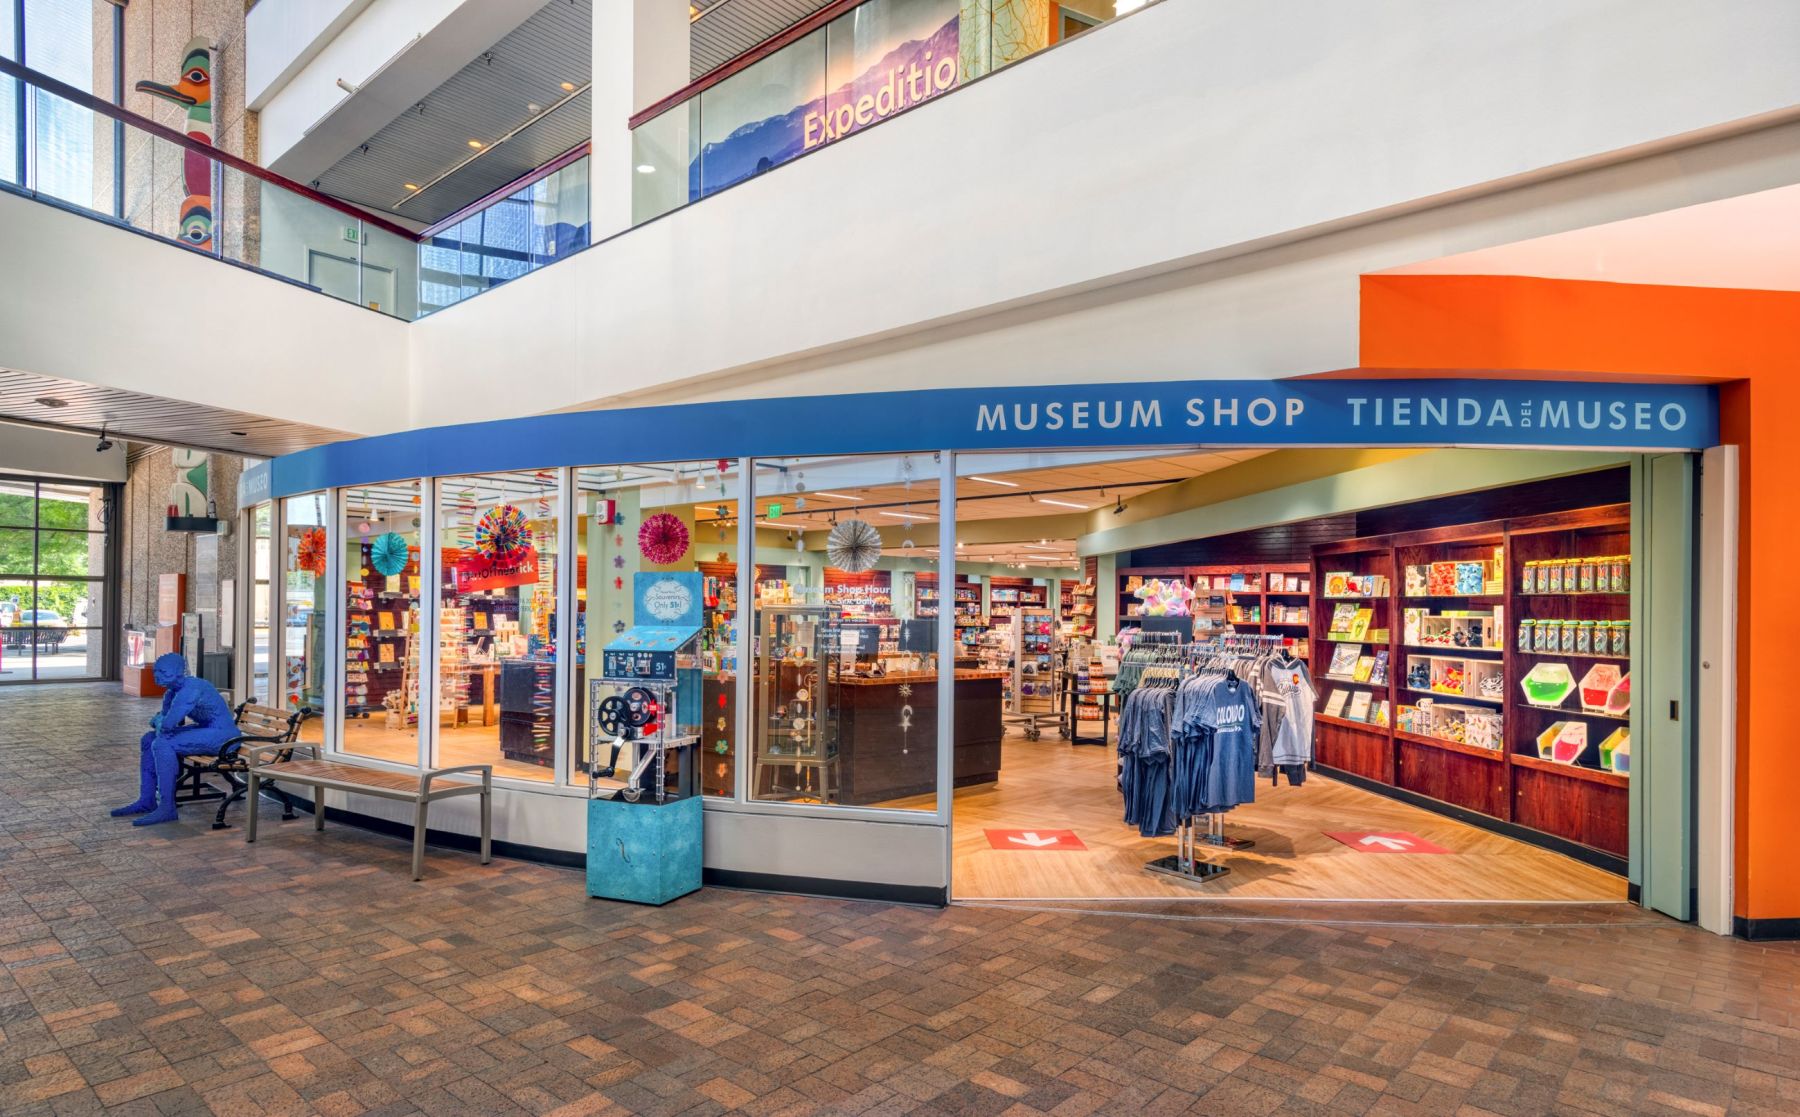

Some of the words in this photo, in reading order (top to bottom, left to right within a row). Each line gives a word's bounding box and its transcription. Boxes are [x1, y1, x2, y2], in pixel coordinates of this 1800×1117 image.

[975, 400, 1163, 431] MUSEUM
[1186, 397, 1305, 427] SHOP
[1347, 397, 1513, 427] TIENDA
[1520, 400, 1532, 427] DEL
[1540, 400, 1687, 431] MUSEO
[837, 584, 863, 597] Shop
